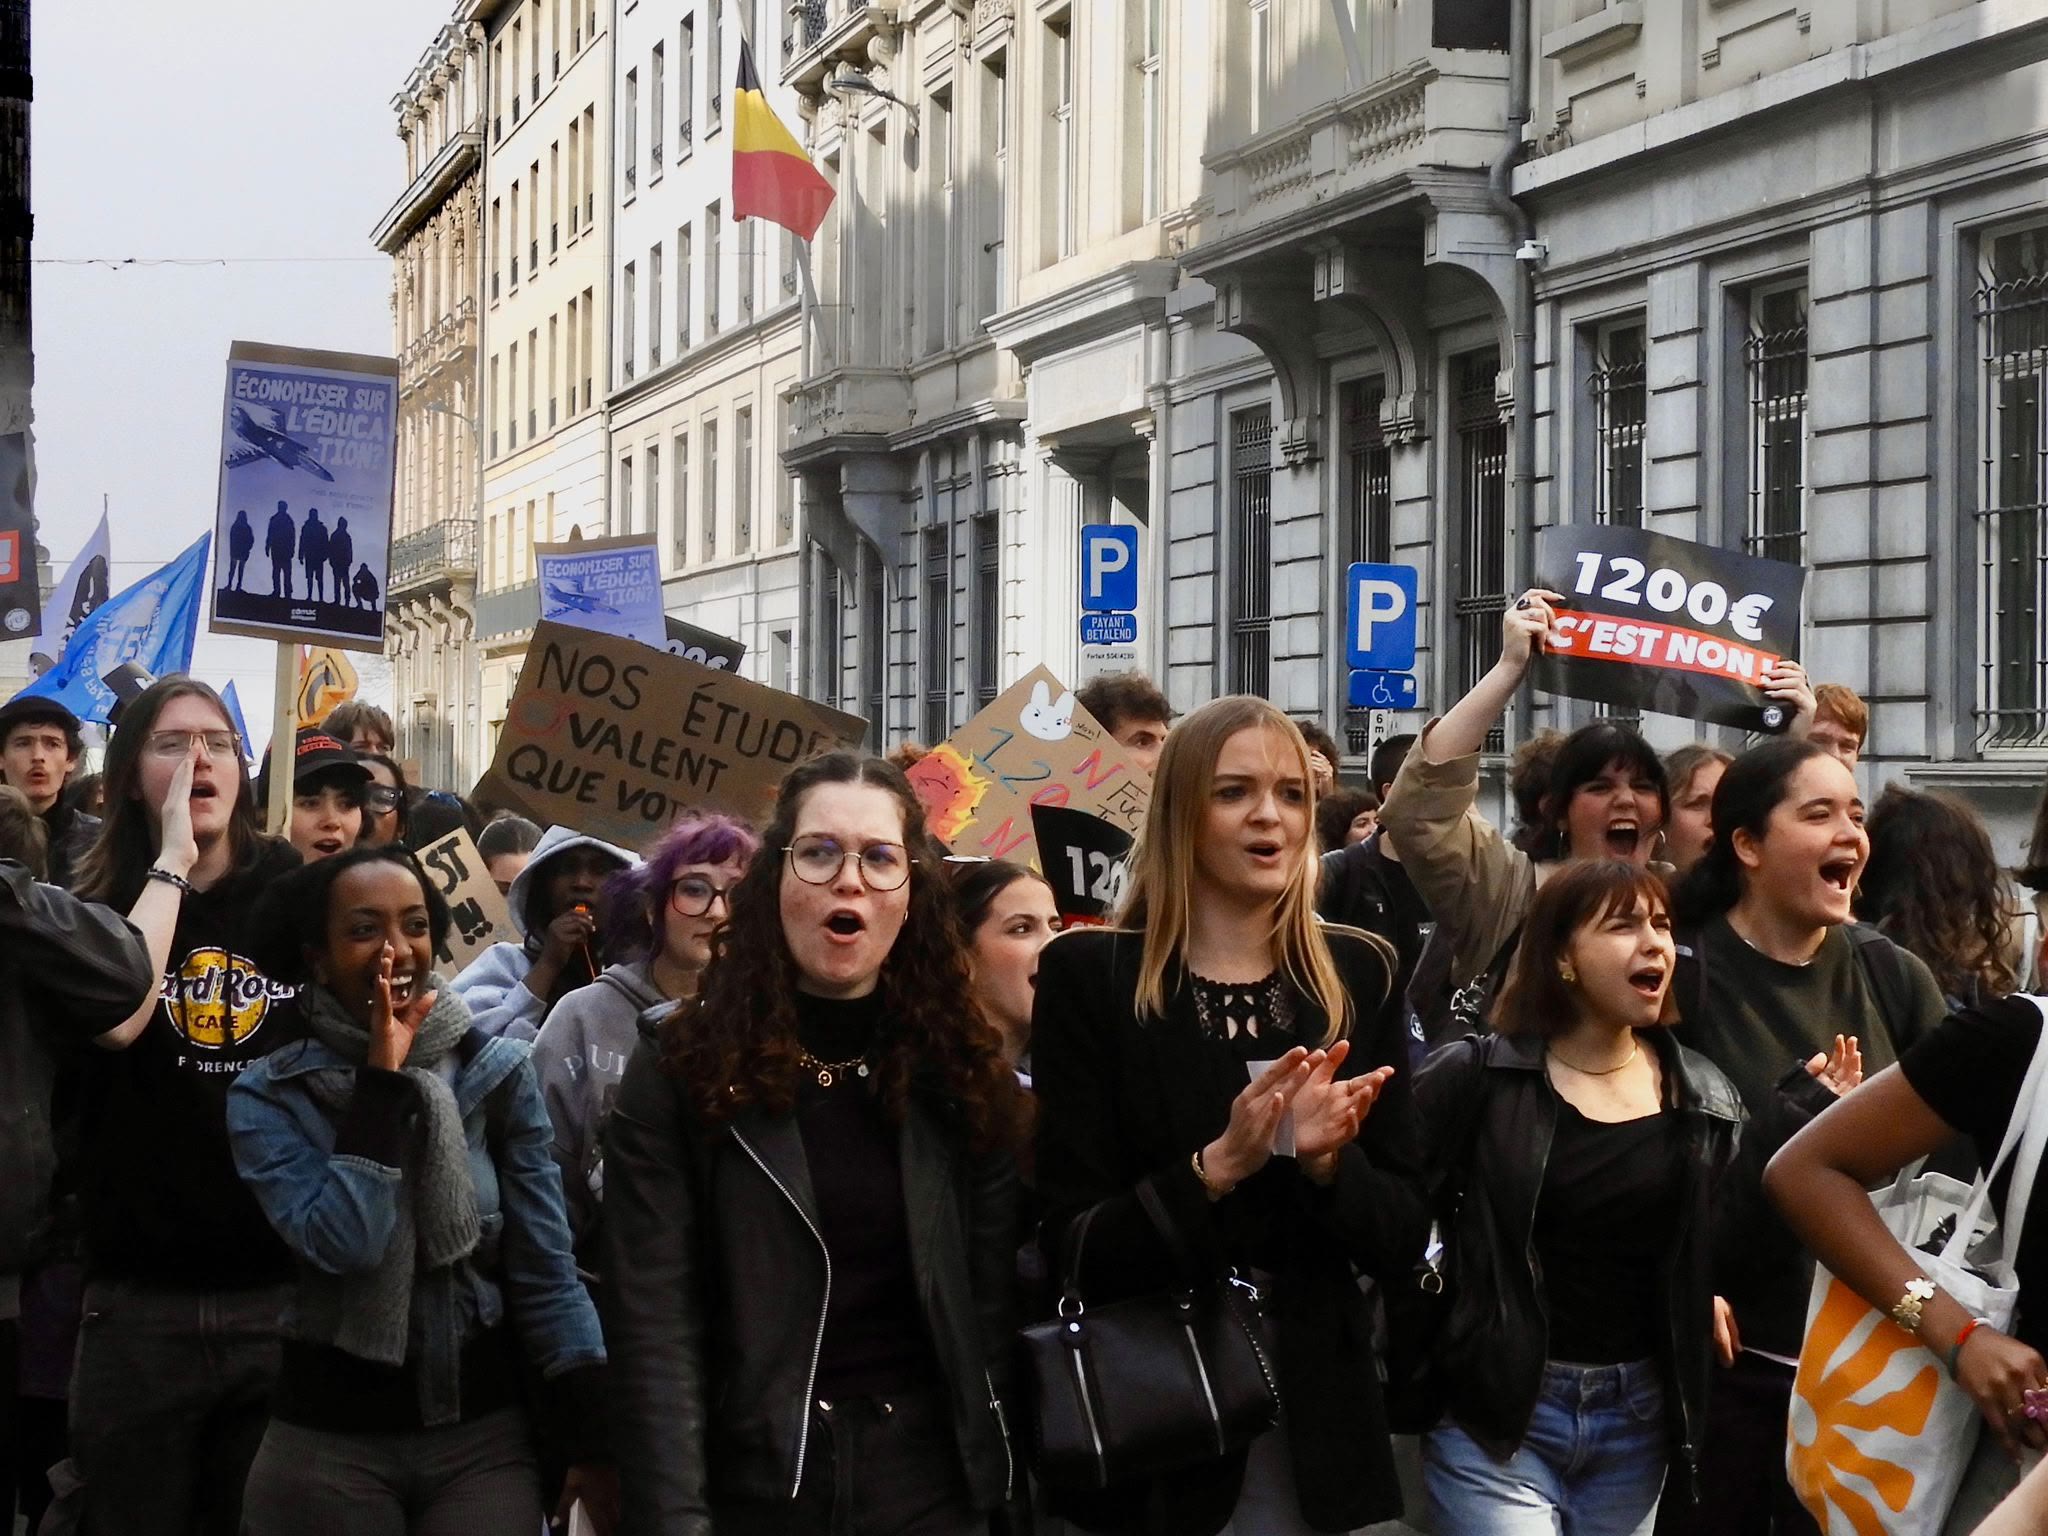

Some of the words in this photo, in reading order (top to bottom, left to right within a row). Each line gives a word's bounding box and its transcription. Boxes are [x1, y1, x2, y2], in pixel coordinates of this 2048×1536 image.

[234, 371, 349, 409] ÉCONOMISER
[352, 387, 387, 413] SUR
[286, 405, 385, 442] L'ÉDUCA
[545, 557, 624, 578] ÉCONOMISER
[628, 554, 651, 569] SUR
[583, 570, 650, 591] L'ÉDUCA
[1090, 537, 1130, 598] P
[1357, 579, 1407, 652] P
[1574, 552, 1775, 642] 1200€
[1086, 629, 1132, 642] BETALEND
[1091, 616, 1126, 629] PAYANT
[1550, 616, 1663, 659] C'EST
[1665, 632, 1755, 679] NON
[536, 641, 649, 711] NOS
[1374, 725, 1384, 734] m
[1376, 713, 1383, 724] 6
[569, 712, 729, 793] VALENT
[506, 744, 606, 803] QUE
[617, 779, 690, 823] VOT
[159, 965, 219, 1005] ard
